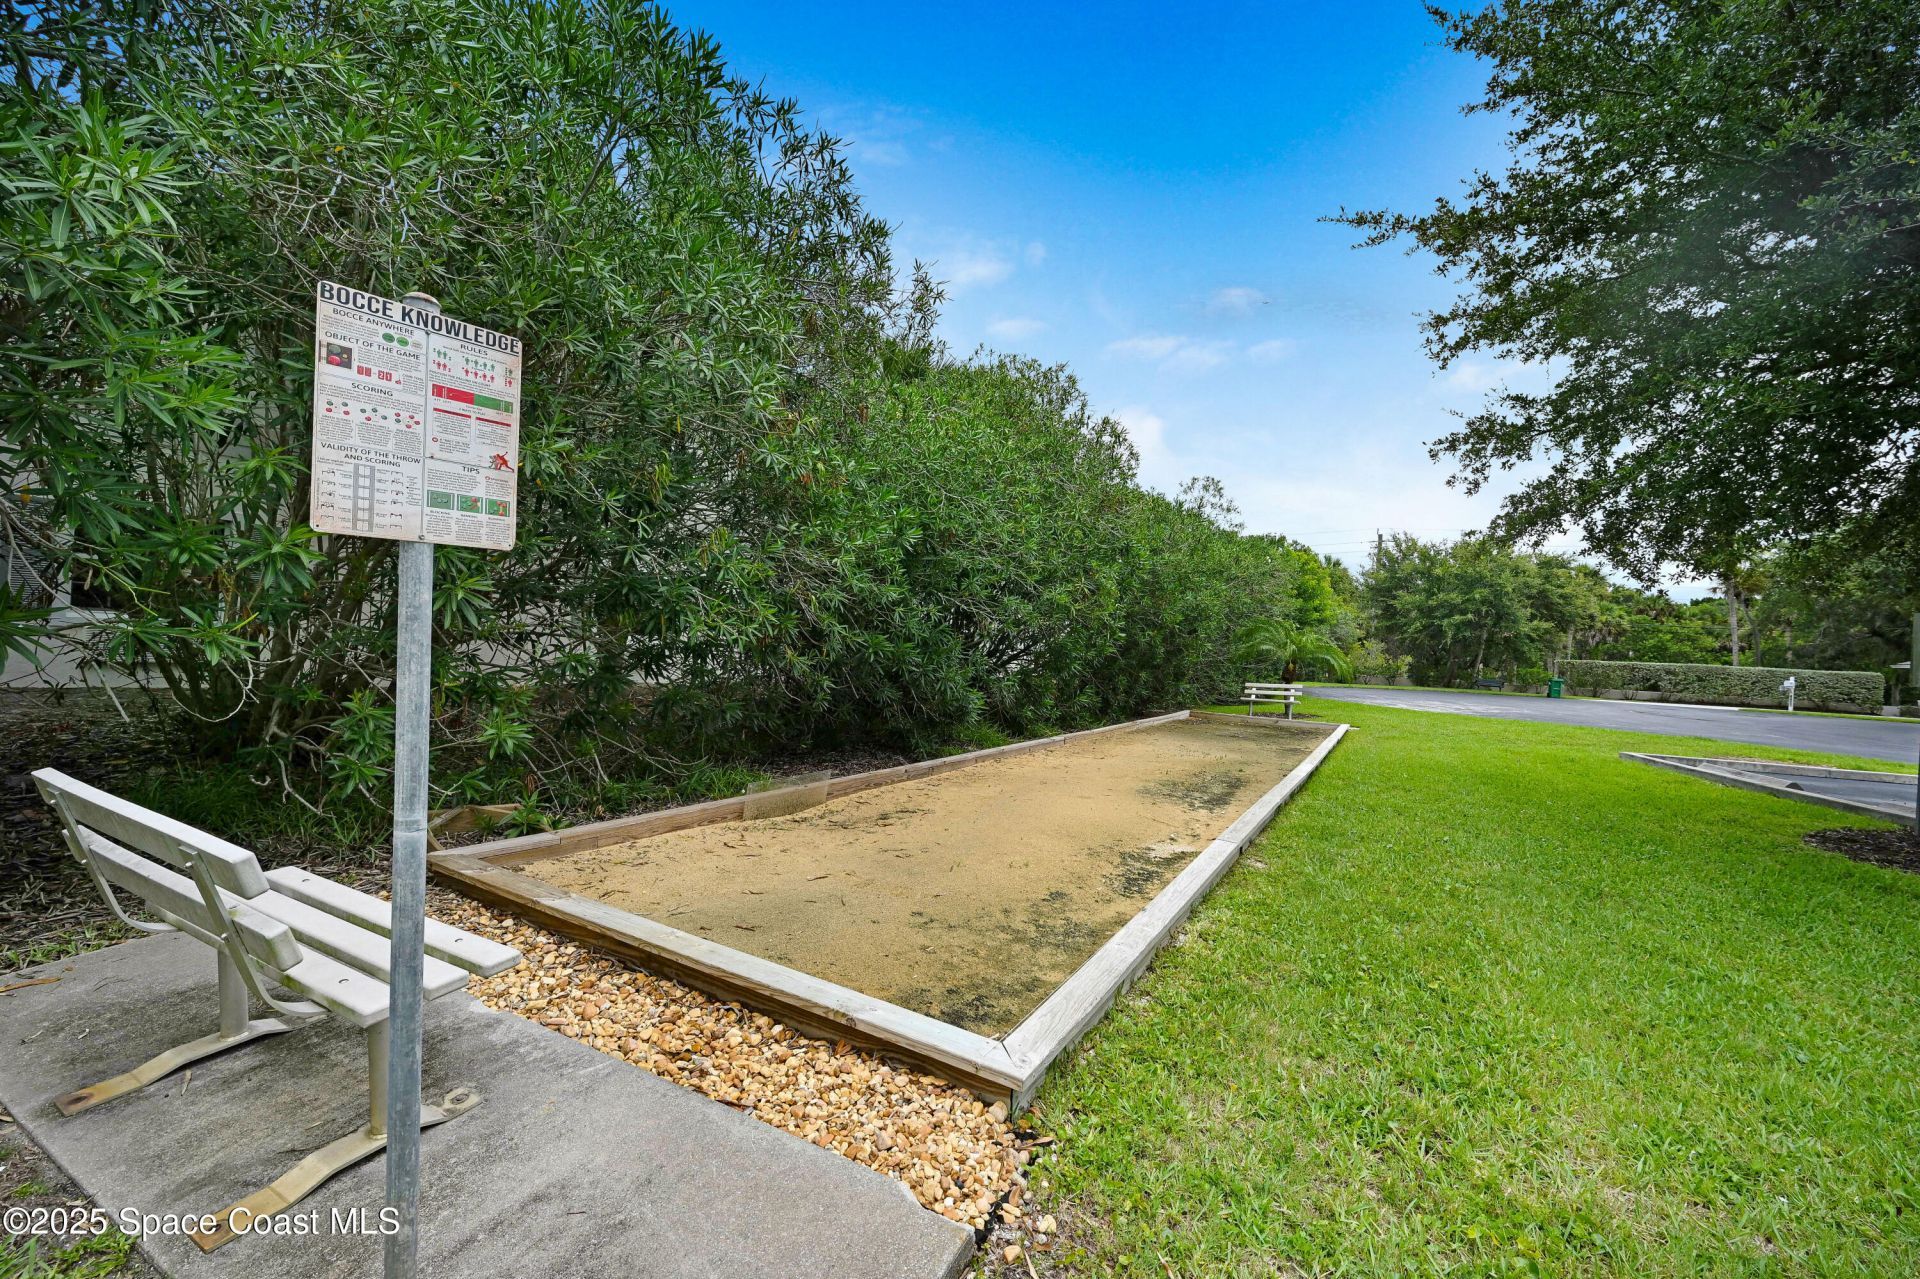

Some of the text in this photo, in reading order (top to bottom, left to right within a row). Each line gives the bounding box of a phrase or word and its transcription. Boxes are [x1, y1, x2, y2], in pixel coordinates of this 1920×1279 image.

[320, 282, 394, 319] BOCCE
[401, 306, 520, 355] KNOWLEDGE
[333, 308, 364, 321] BOCCE
[366, 317, 415, 336] ANYWHERE
[325, 331, 360, 344] OBJECT
[377, 344, 394, 353] THE
[396, 350, 420, 360] GAME
[460, 344, 488, 356] RULES
[351, 382, 393, 397] SCORING
[320, 442, 359, 454] VALIDITY
[374, 450, 389, 458] THE
[391, 453, 421, 464] THROW
[344, 453, 363, 461] AND
[364, 456, 401, 468] SCORING
[462, 466, 480, 475] TIPS
